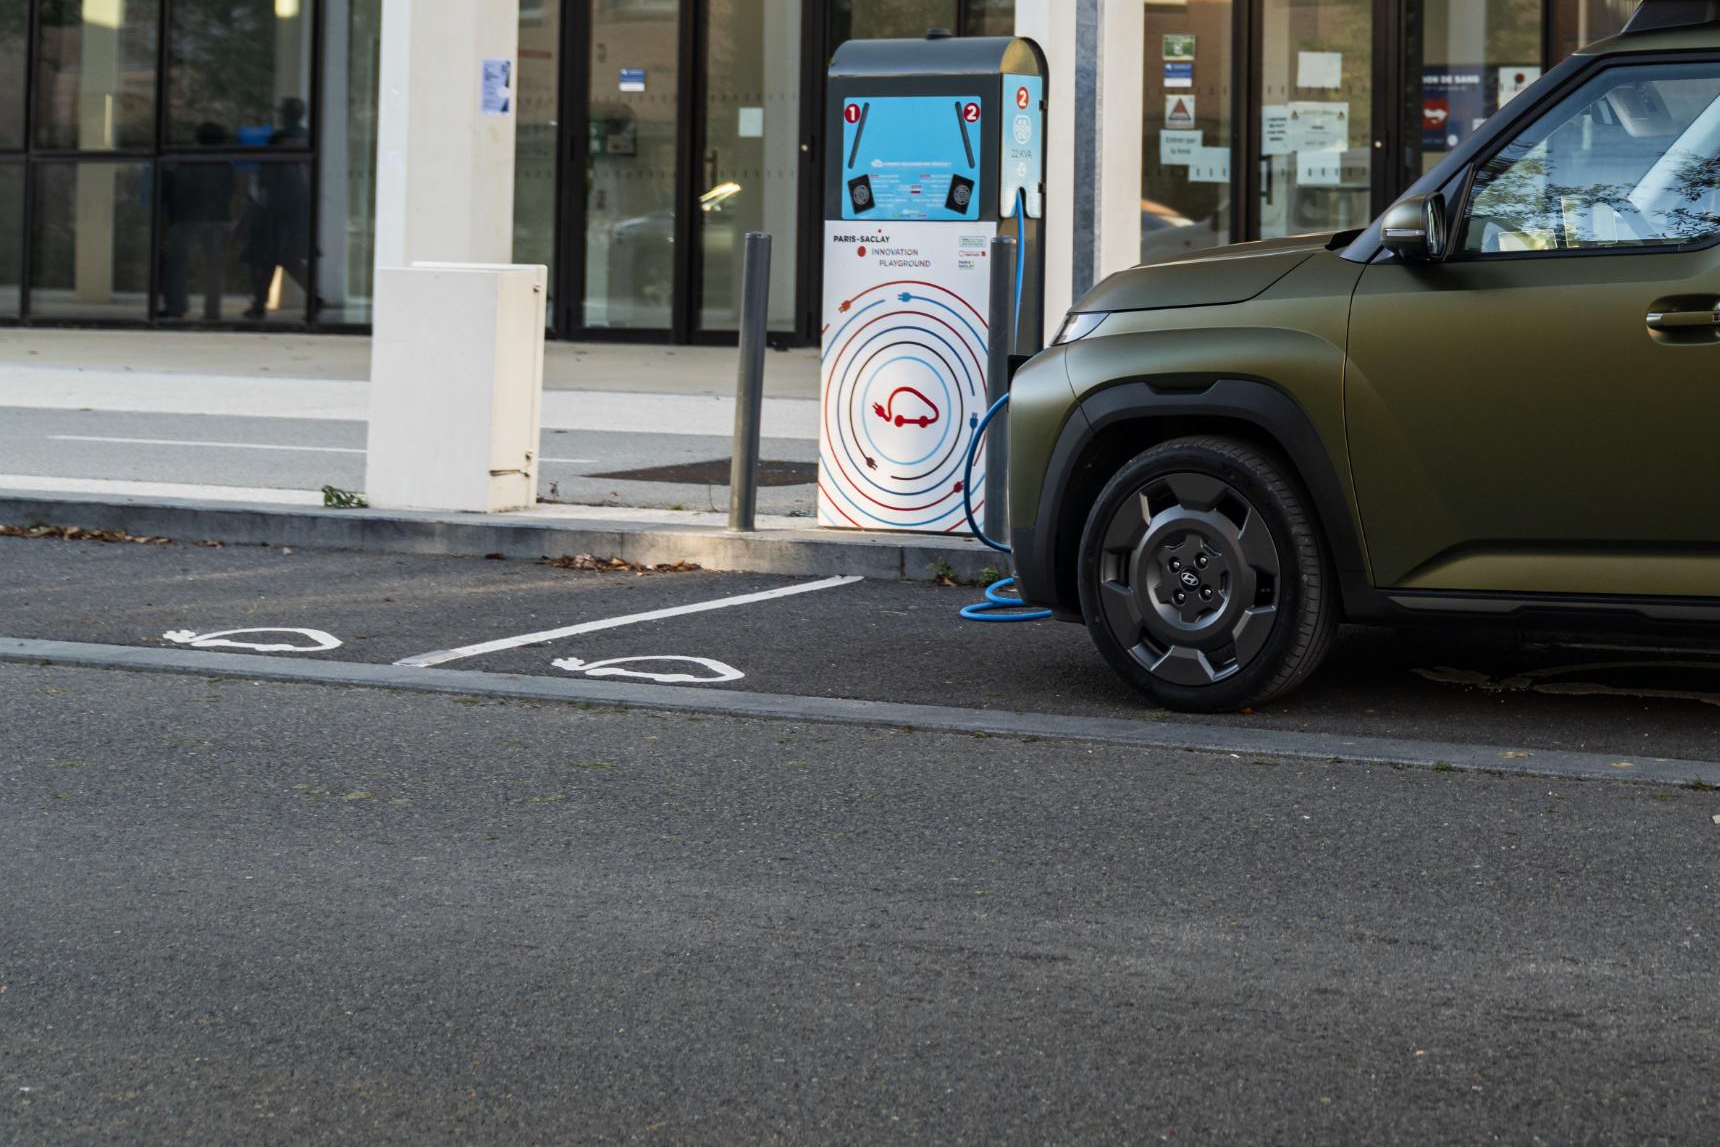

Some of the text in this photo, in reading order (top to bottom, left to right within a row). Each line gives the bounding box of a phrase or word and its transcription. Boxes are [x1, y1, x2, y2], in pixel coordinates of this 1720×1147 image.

[1018, 90, 1027, 107] 2
[849, 106, 856, 121] 1
[967, 105, 977, 120] 2
[833, 235, 890, 243] PARIS-SACLAY
[872, 248, 919, 256] INNOVATION
[880, 259, 931, 267] PLAYGROUND
